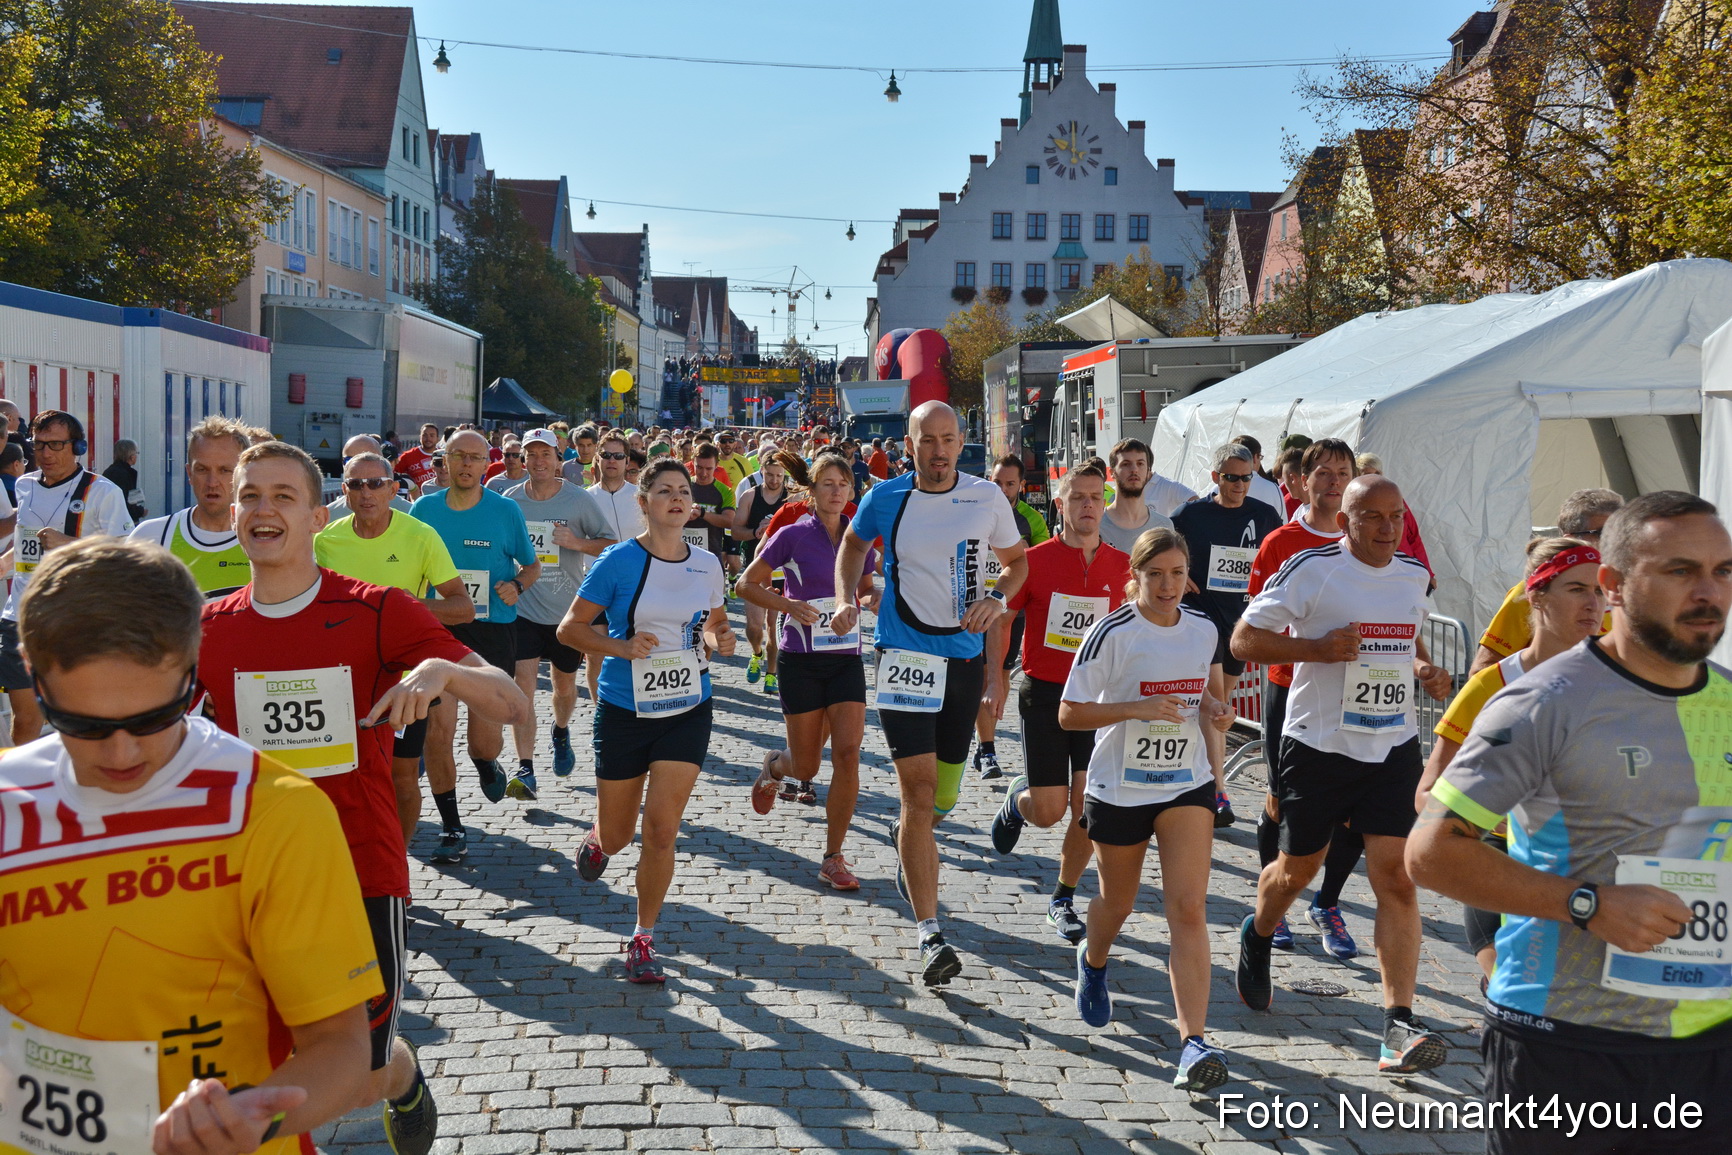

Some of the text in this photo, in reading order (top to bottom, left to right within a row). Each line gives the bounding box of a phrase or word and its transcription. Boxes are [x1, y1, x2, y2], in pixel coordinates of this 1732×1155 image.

[733, 370, 768, 380] START
[464, 539, 491, 547] BOCK
[682, 536, 703, 545] 3102
[1217, 558, 1251, 575] 2388
[957, 556, 965, 617] TECHNOLOGY
[1068, 601, 1095, 609] BOCK
[1061, 612, 1095, 630] 204
[1360, 642, 1410, 652] achmaier
[652, 657, 682, 667] BOCK
[899, 655, 928, 666] BOCK
[643, 667, 692, 692] 2492
[887, 665, 936, 688] 2494
[1369, 669, 1400, 678] BOCK
[266, 679, 317, 692] BOCK
[1143, 682, 1203, 693] AUTOMOBILE
[1355, 682, 1406, 705] 2196
[652, 699, 687, 711] Christina
[893, 695, 925, 706] Michael
[263, 700, 326, 734] 335
[1149, 725, 1181, 733] BOCK
[287, 737, 322, 745] Neumarkt
[1136, 737, 1189, 760] 2197
[1145, 773, 1175, 782] Nadine
[107, 854, 242, 906] BÖGL
[1661, 870, 1717, 888] BOCK
[1651, 945, 1714, 957] ARTL Neumarkt
[1662, 965, 1704, 983] Erich
[25, 1038, 94, 1075] BOCK
[18, 1074, 107, 1143] 258
[19, 1131, 49, 1152] PARTL
